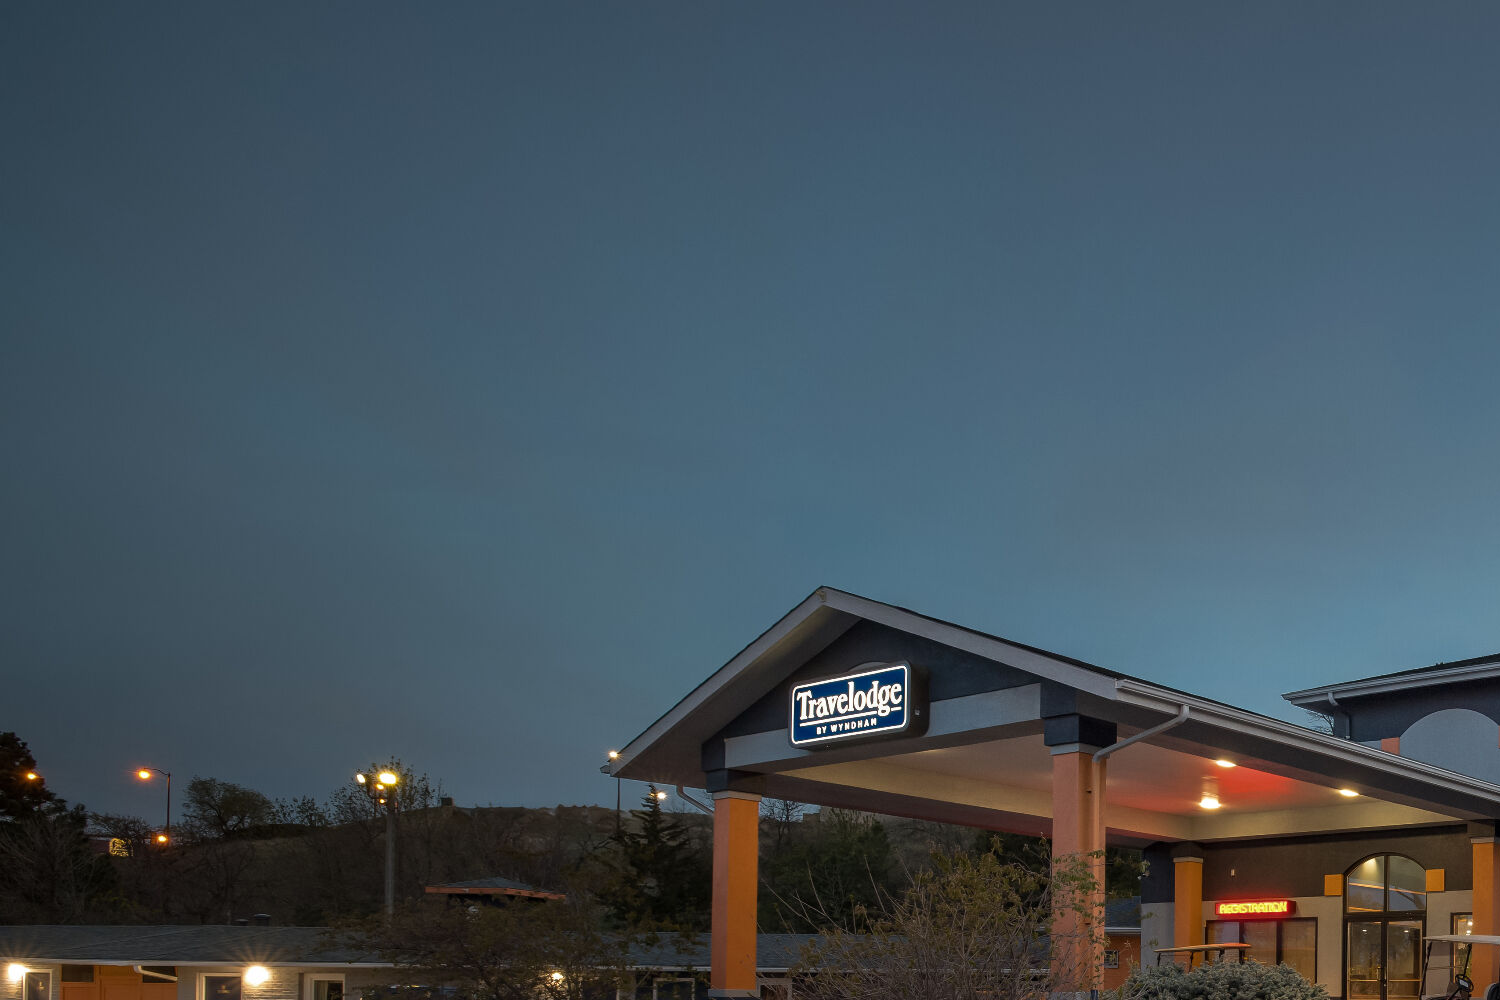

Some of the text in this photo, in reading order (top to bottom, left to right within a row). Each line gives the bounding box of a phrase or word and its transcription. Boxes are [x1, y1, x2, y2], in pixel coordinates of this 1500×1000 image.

[796, 680, 902, 720] Travelodge
[816, 718, 877, 735] BY WYNDHAM
[1219, 901, 1288, 914] REGISTRATION
